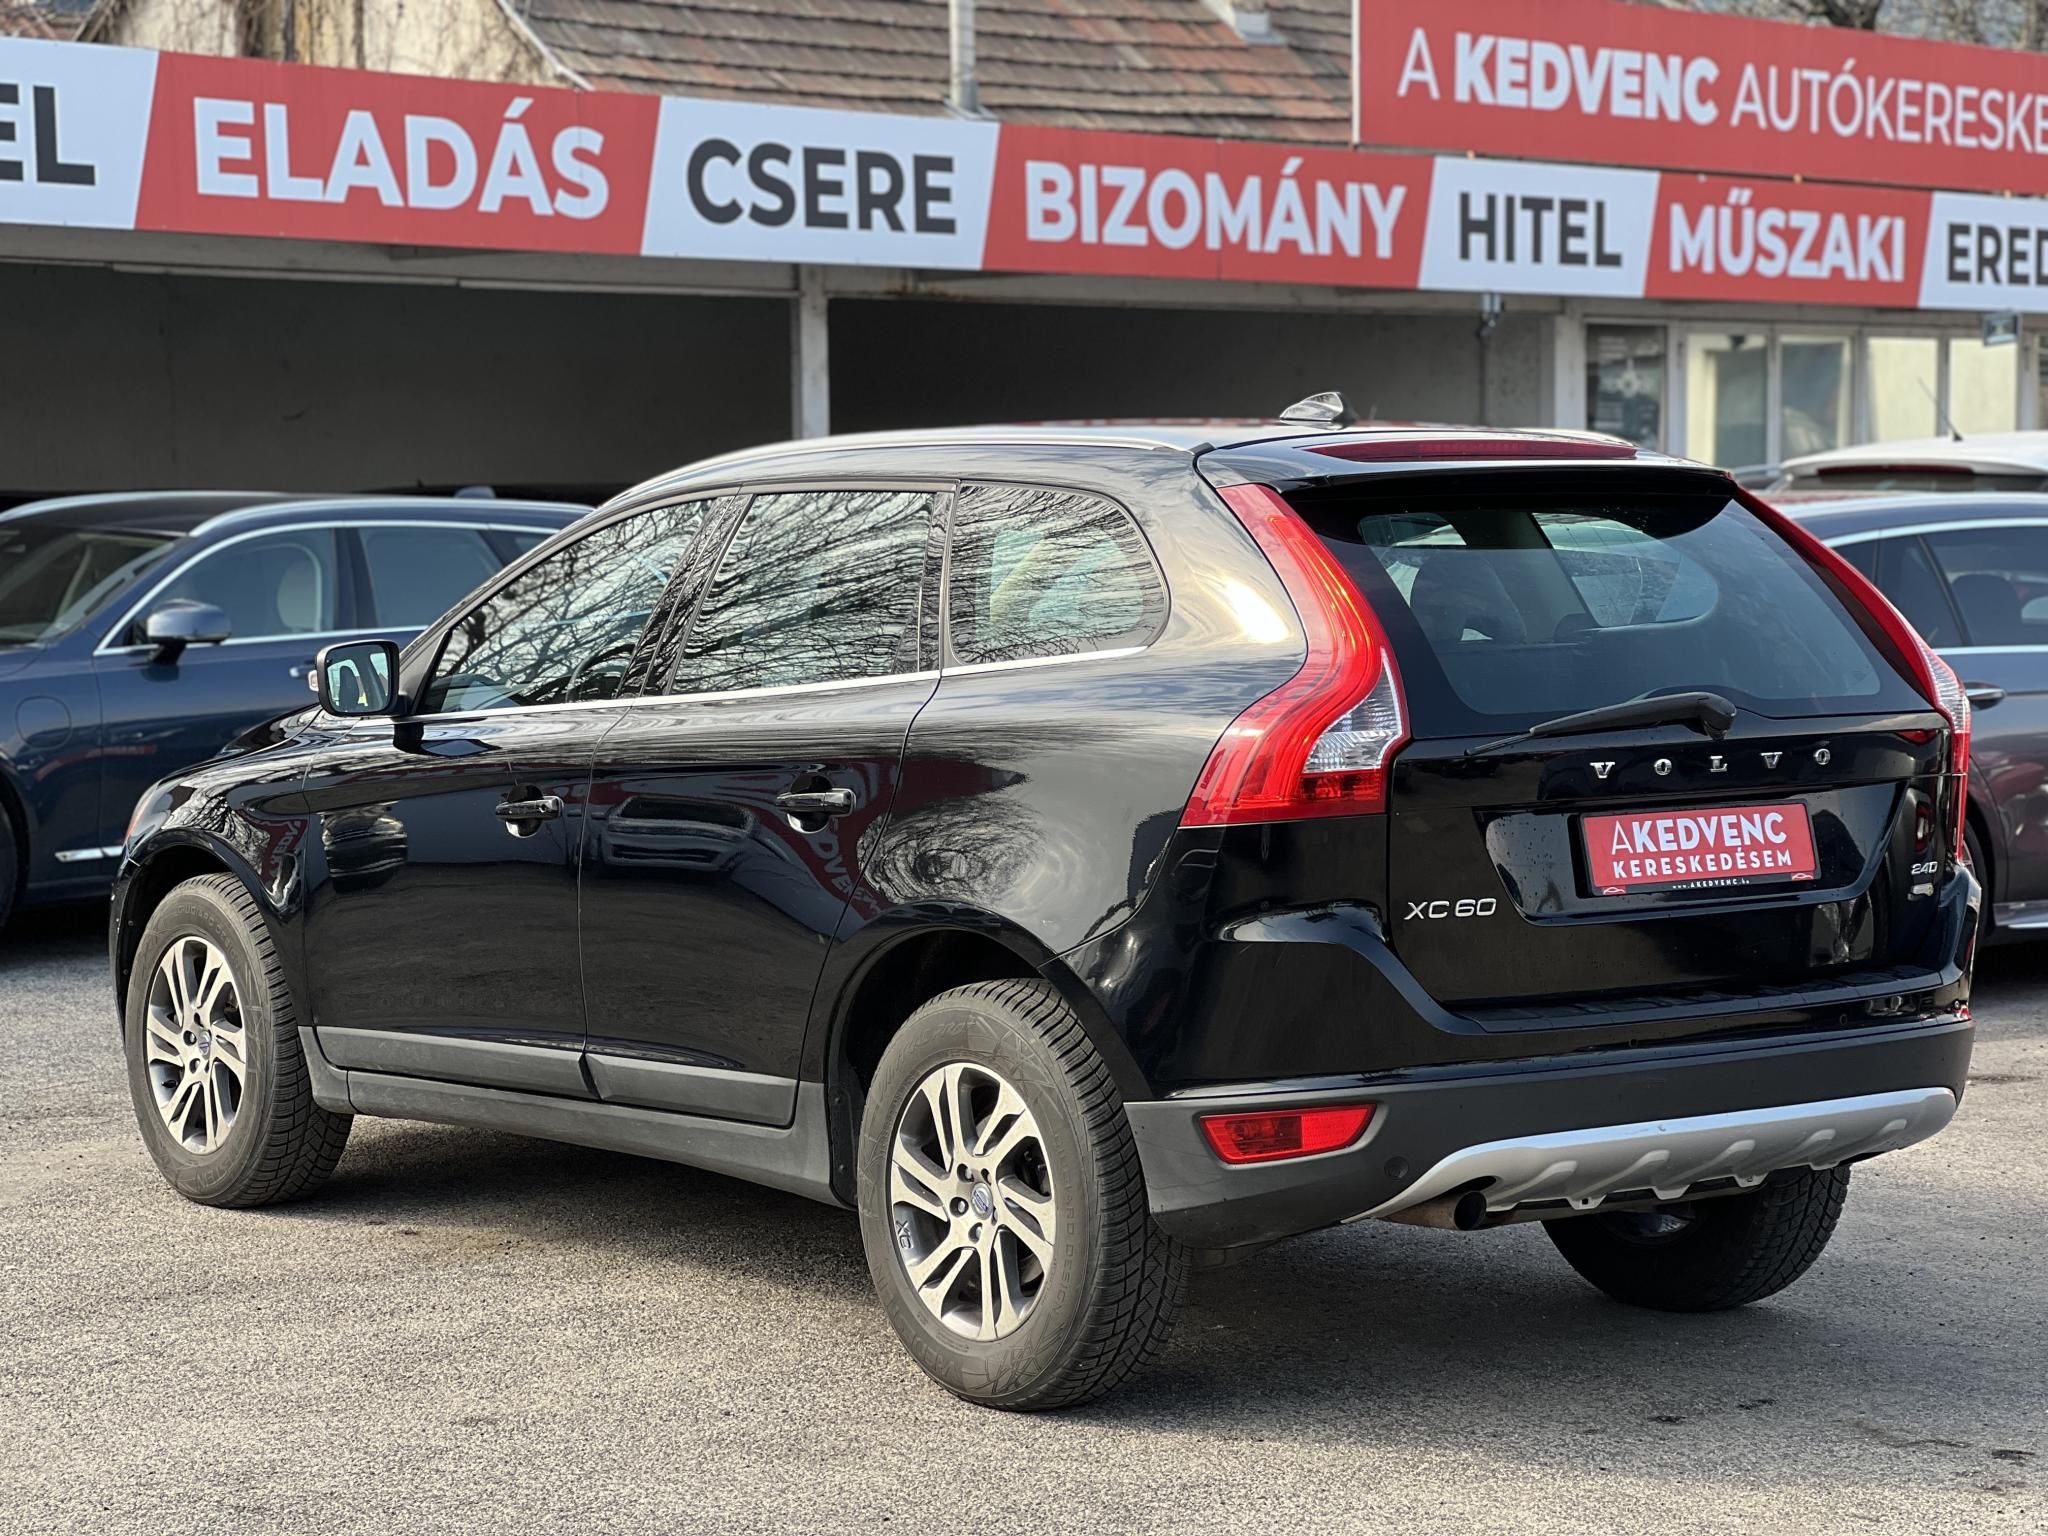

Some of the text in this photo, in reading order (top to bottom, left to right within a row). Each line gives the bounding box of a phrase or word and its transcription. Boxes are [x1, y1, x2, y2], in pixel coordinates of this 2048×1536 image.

[1397, 27, 1441, 100] A
[1454, 32, 1720, 126] KEDVENC
[193, 97, 609, 220] ELADÁS
[688, 138, 955, 234] CSERE
[1024, 158, 1406, 259] BIZOMÁNY
[1460, 193, 1621, 266] HITEL
[1669, 187, 1906, 283] MŰSZAKI
[1590, 748, 1831, 778] VOLVO
[1612, 847, 1792, 879] KERESKEDÉSEM
